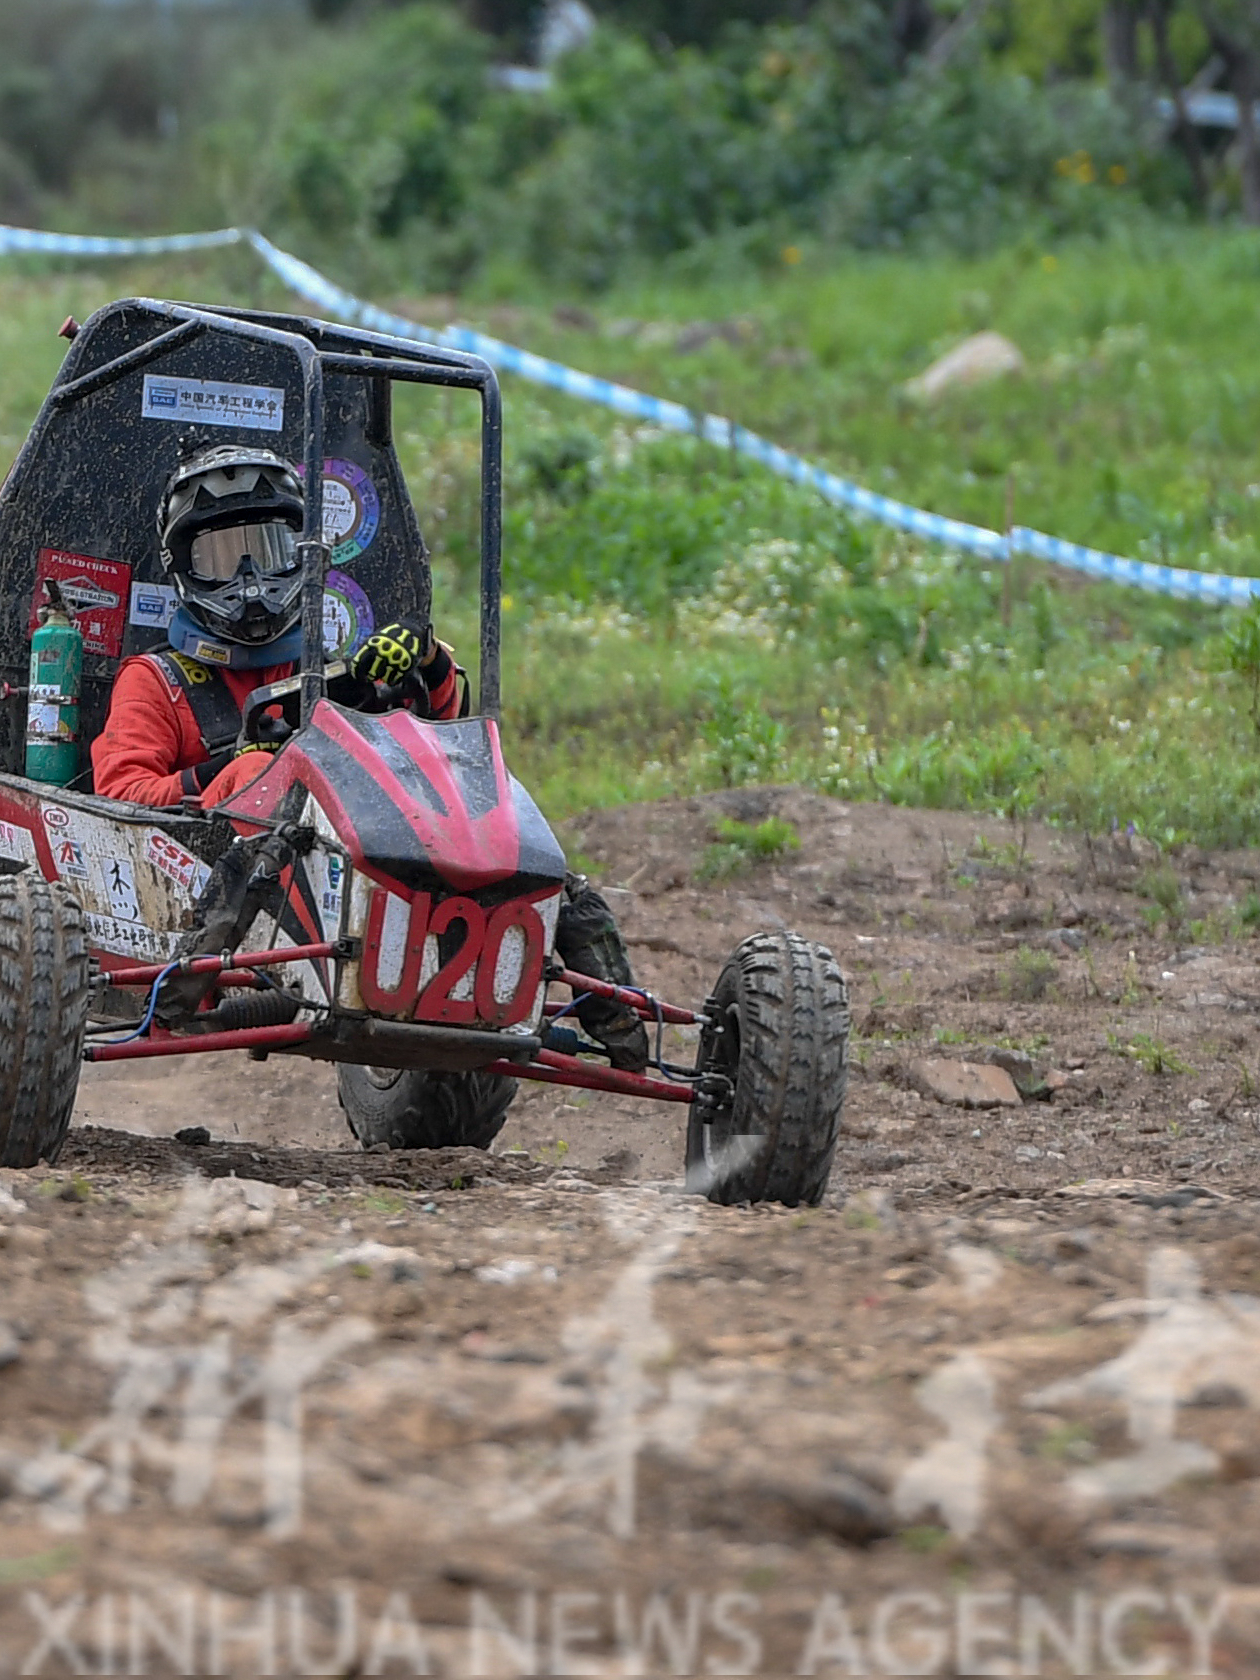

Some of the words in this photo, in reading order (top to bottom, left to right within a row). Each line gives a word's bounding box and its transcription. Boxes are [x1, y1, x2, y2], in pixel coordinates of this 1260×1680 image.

[180, 390, 278, 411] 中国汽车工程学会
[151, 834, 195, 867] CST
[360, 889, 547, 1027] U20
